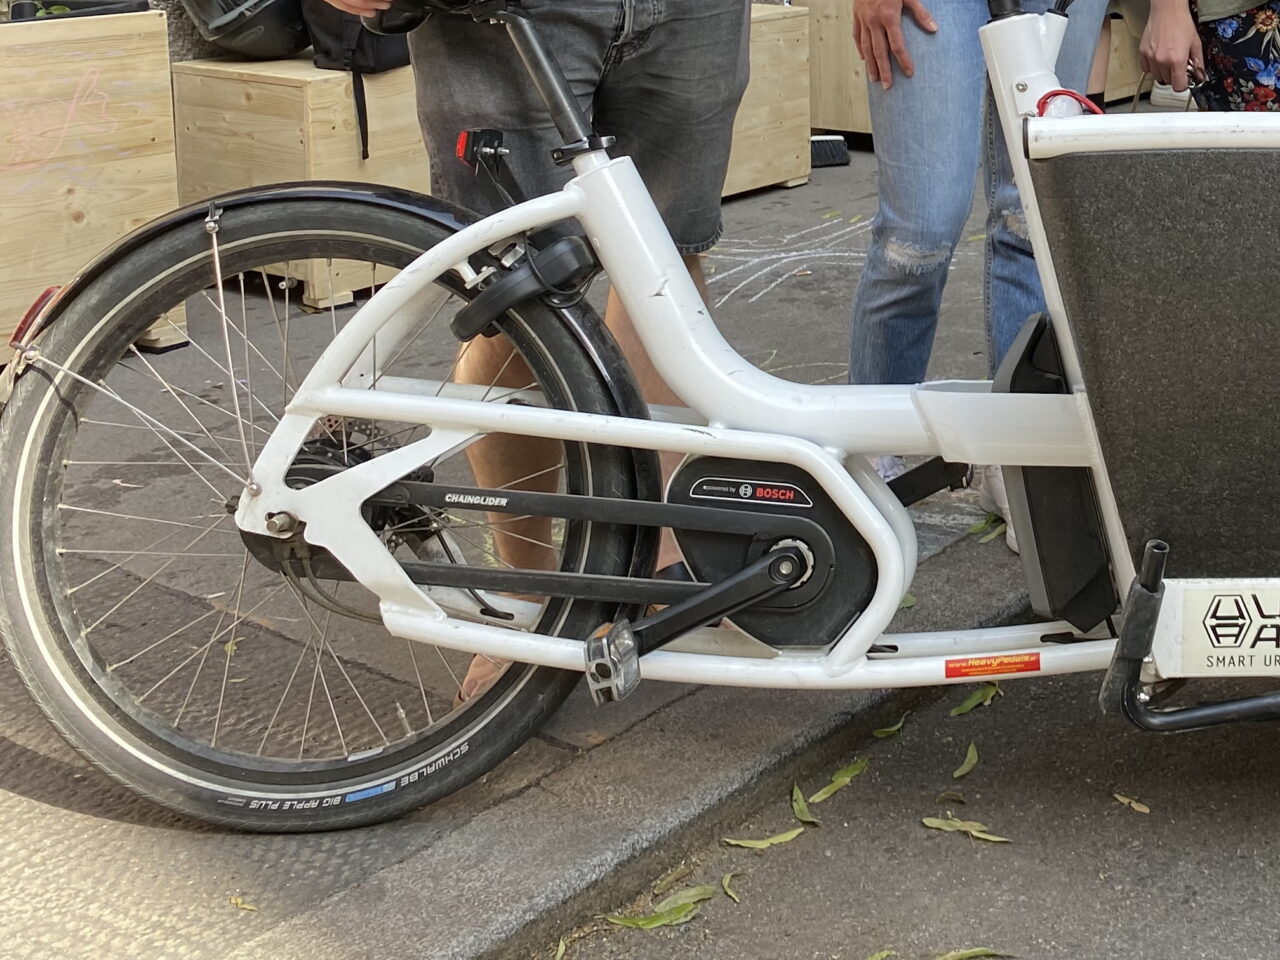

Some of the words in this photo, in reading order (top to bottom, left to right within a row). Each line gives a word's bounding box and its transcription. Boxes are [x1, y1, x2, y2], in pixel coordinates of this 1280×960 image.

[445, 493, 508, 506] CHAINGLIDER
[756, 487, 794, 500] BOSCH
[1206, 654, 1256, 668] SMART
[401, 741, 469, 787] SCHWALBE
[248, 799, 278, 811] PLUS
[282, 798, 320, 810] APPLE
[322, 795, 342, 808] BIG
